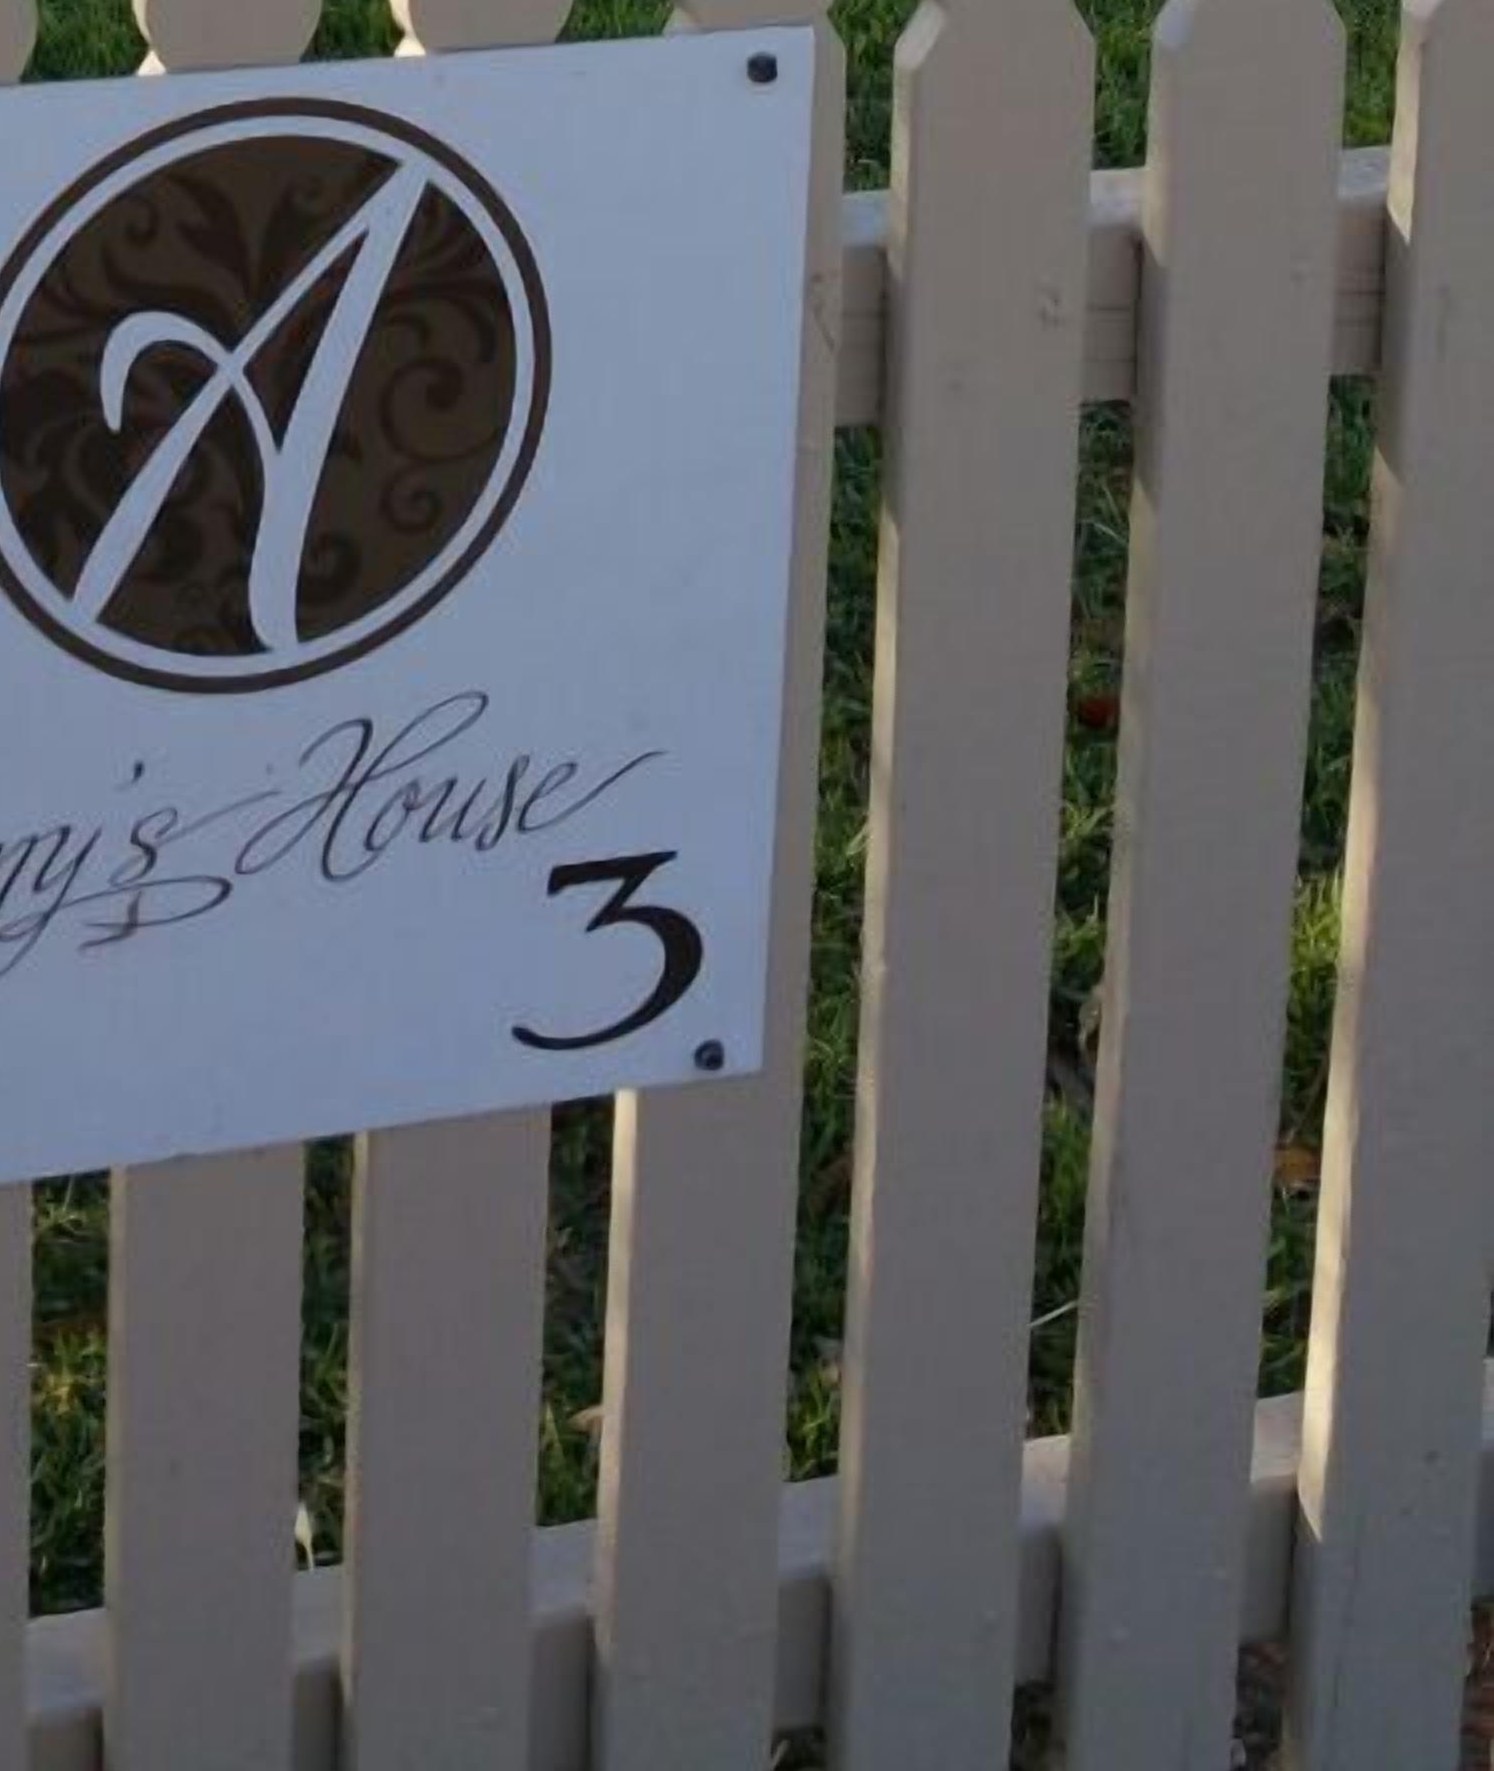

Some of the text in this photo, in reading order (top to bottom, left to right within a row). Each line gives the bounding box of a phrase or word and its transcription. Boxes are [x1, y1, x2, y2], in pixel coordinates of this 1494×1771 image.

[66, 156, 431, 652] A
[234, 690, 669, 882] House
[511, 850, 703, 1050] 3
